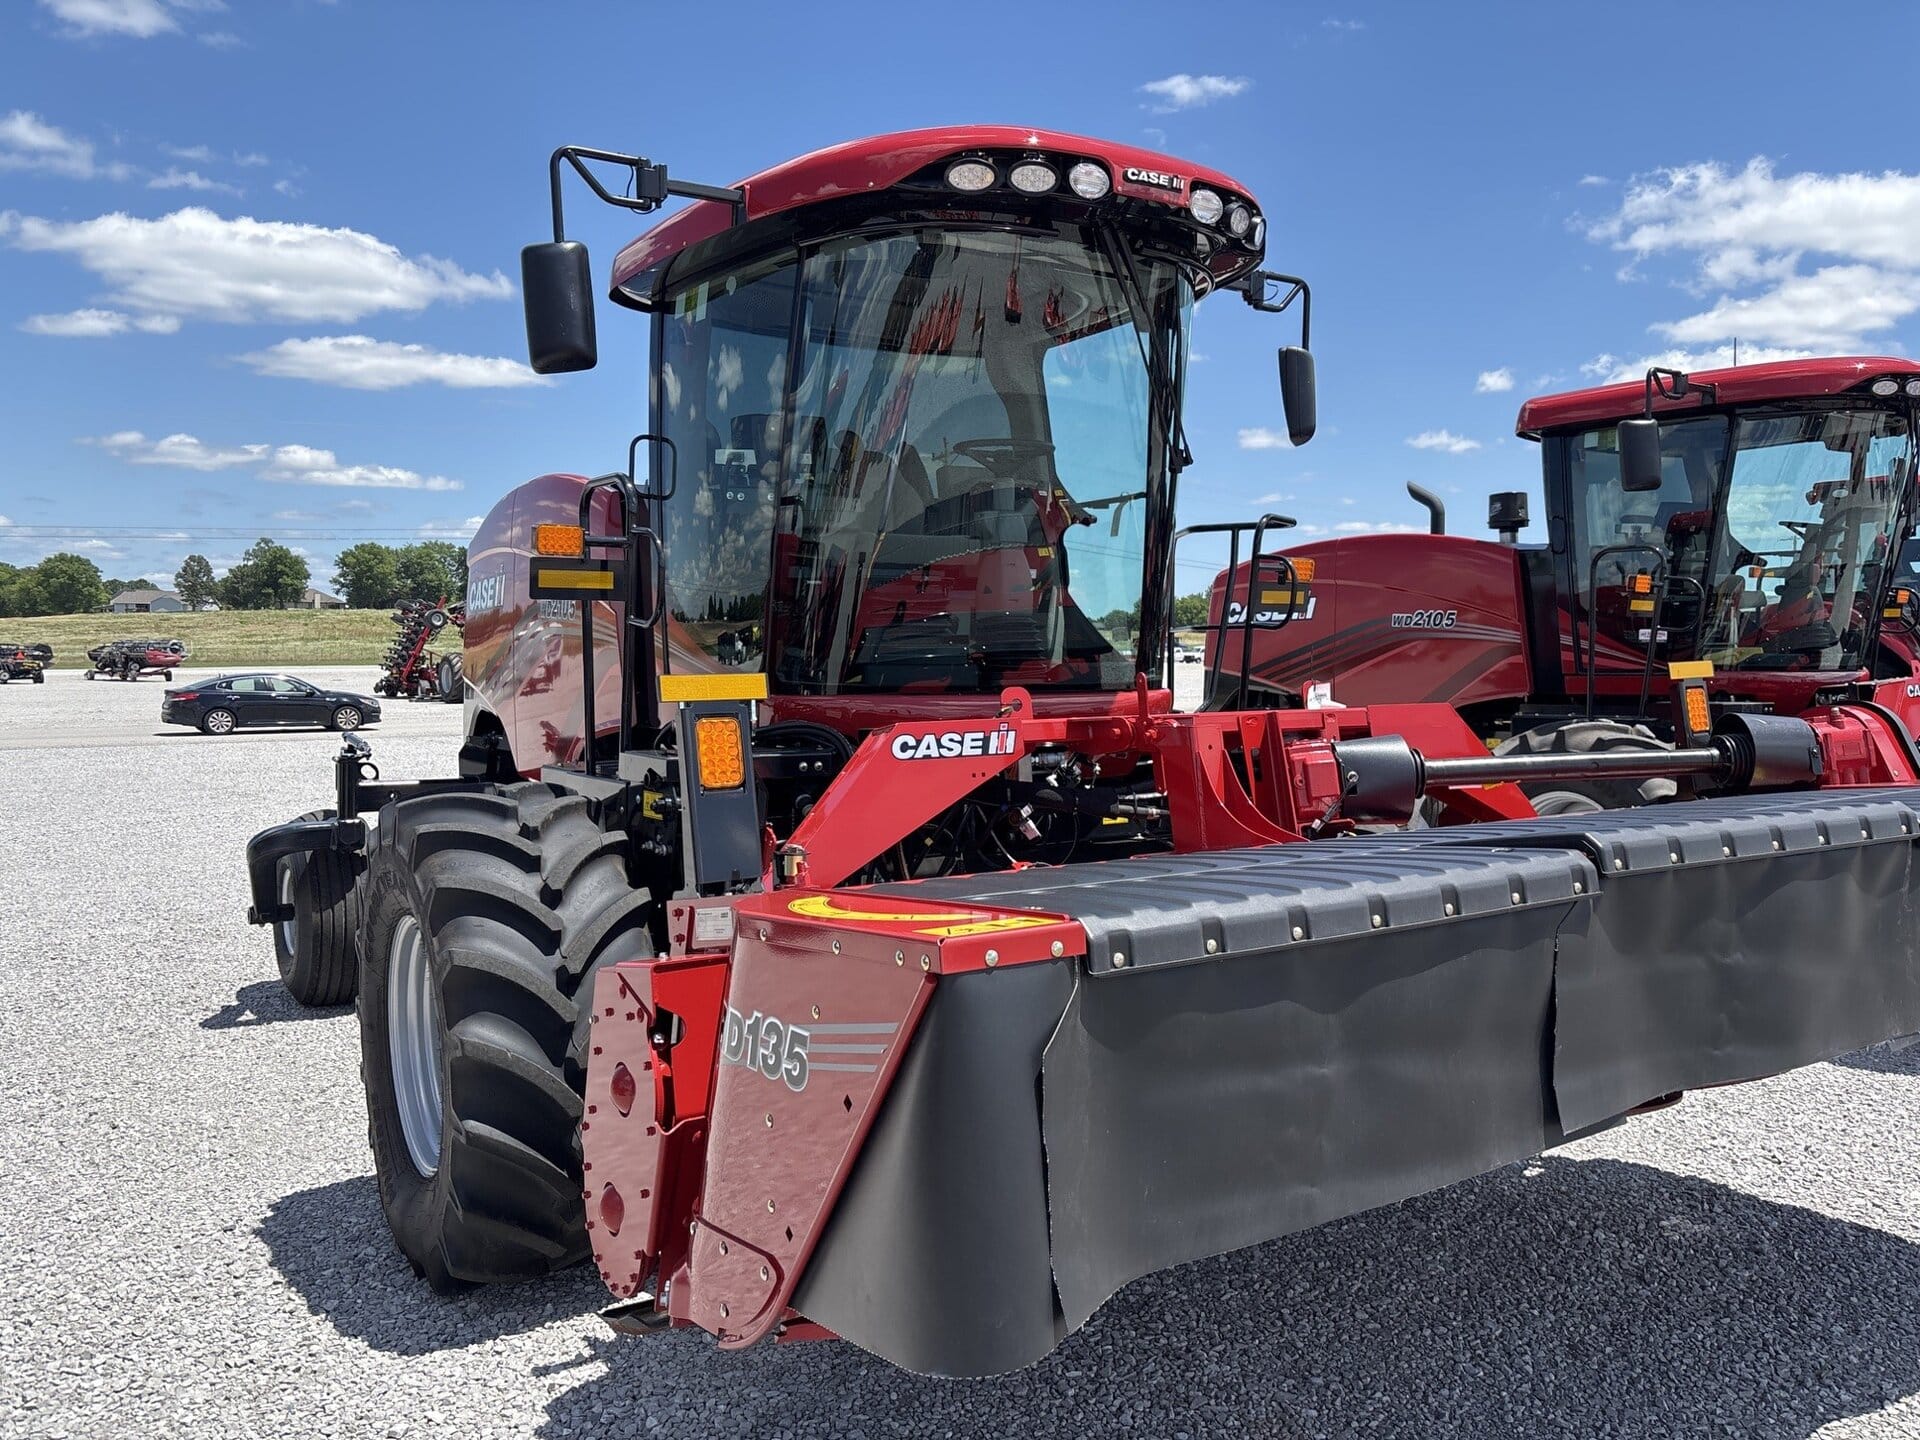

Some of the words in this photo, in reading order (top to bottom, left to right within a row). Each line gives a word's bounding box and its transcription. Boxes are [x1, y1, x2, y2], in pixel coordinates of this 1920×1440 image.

[1127, 168, 1169, 186] CASE
[469, 577, 496, 612] CASE
[1392, 609, 1457, 629] WD2105
[1907, 684, 1920, 698] CA
[891, 731, 985, 760] CASE
